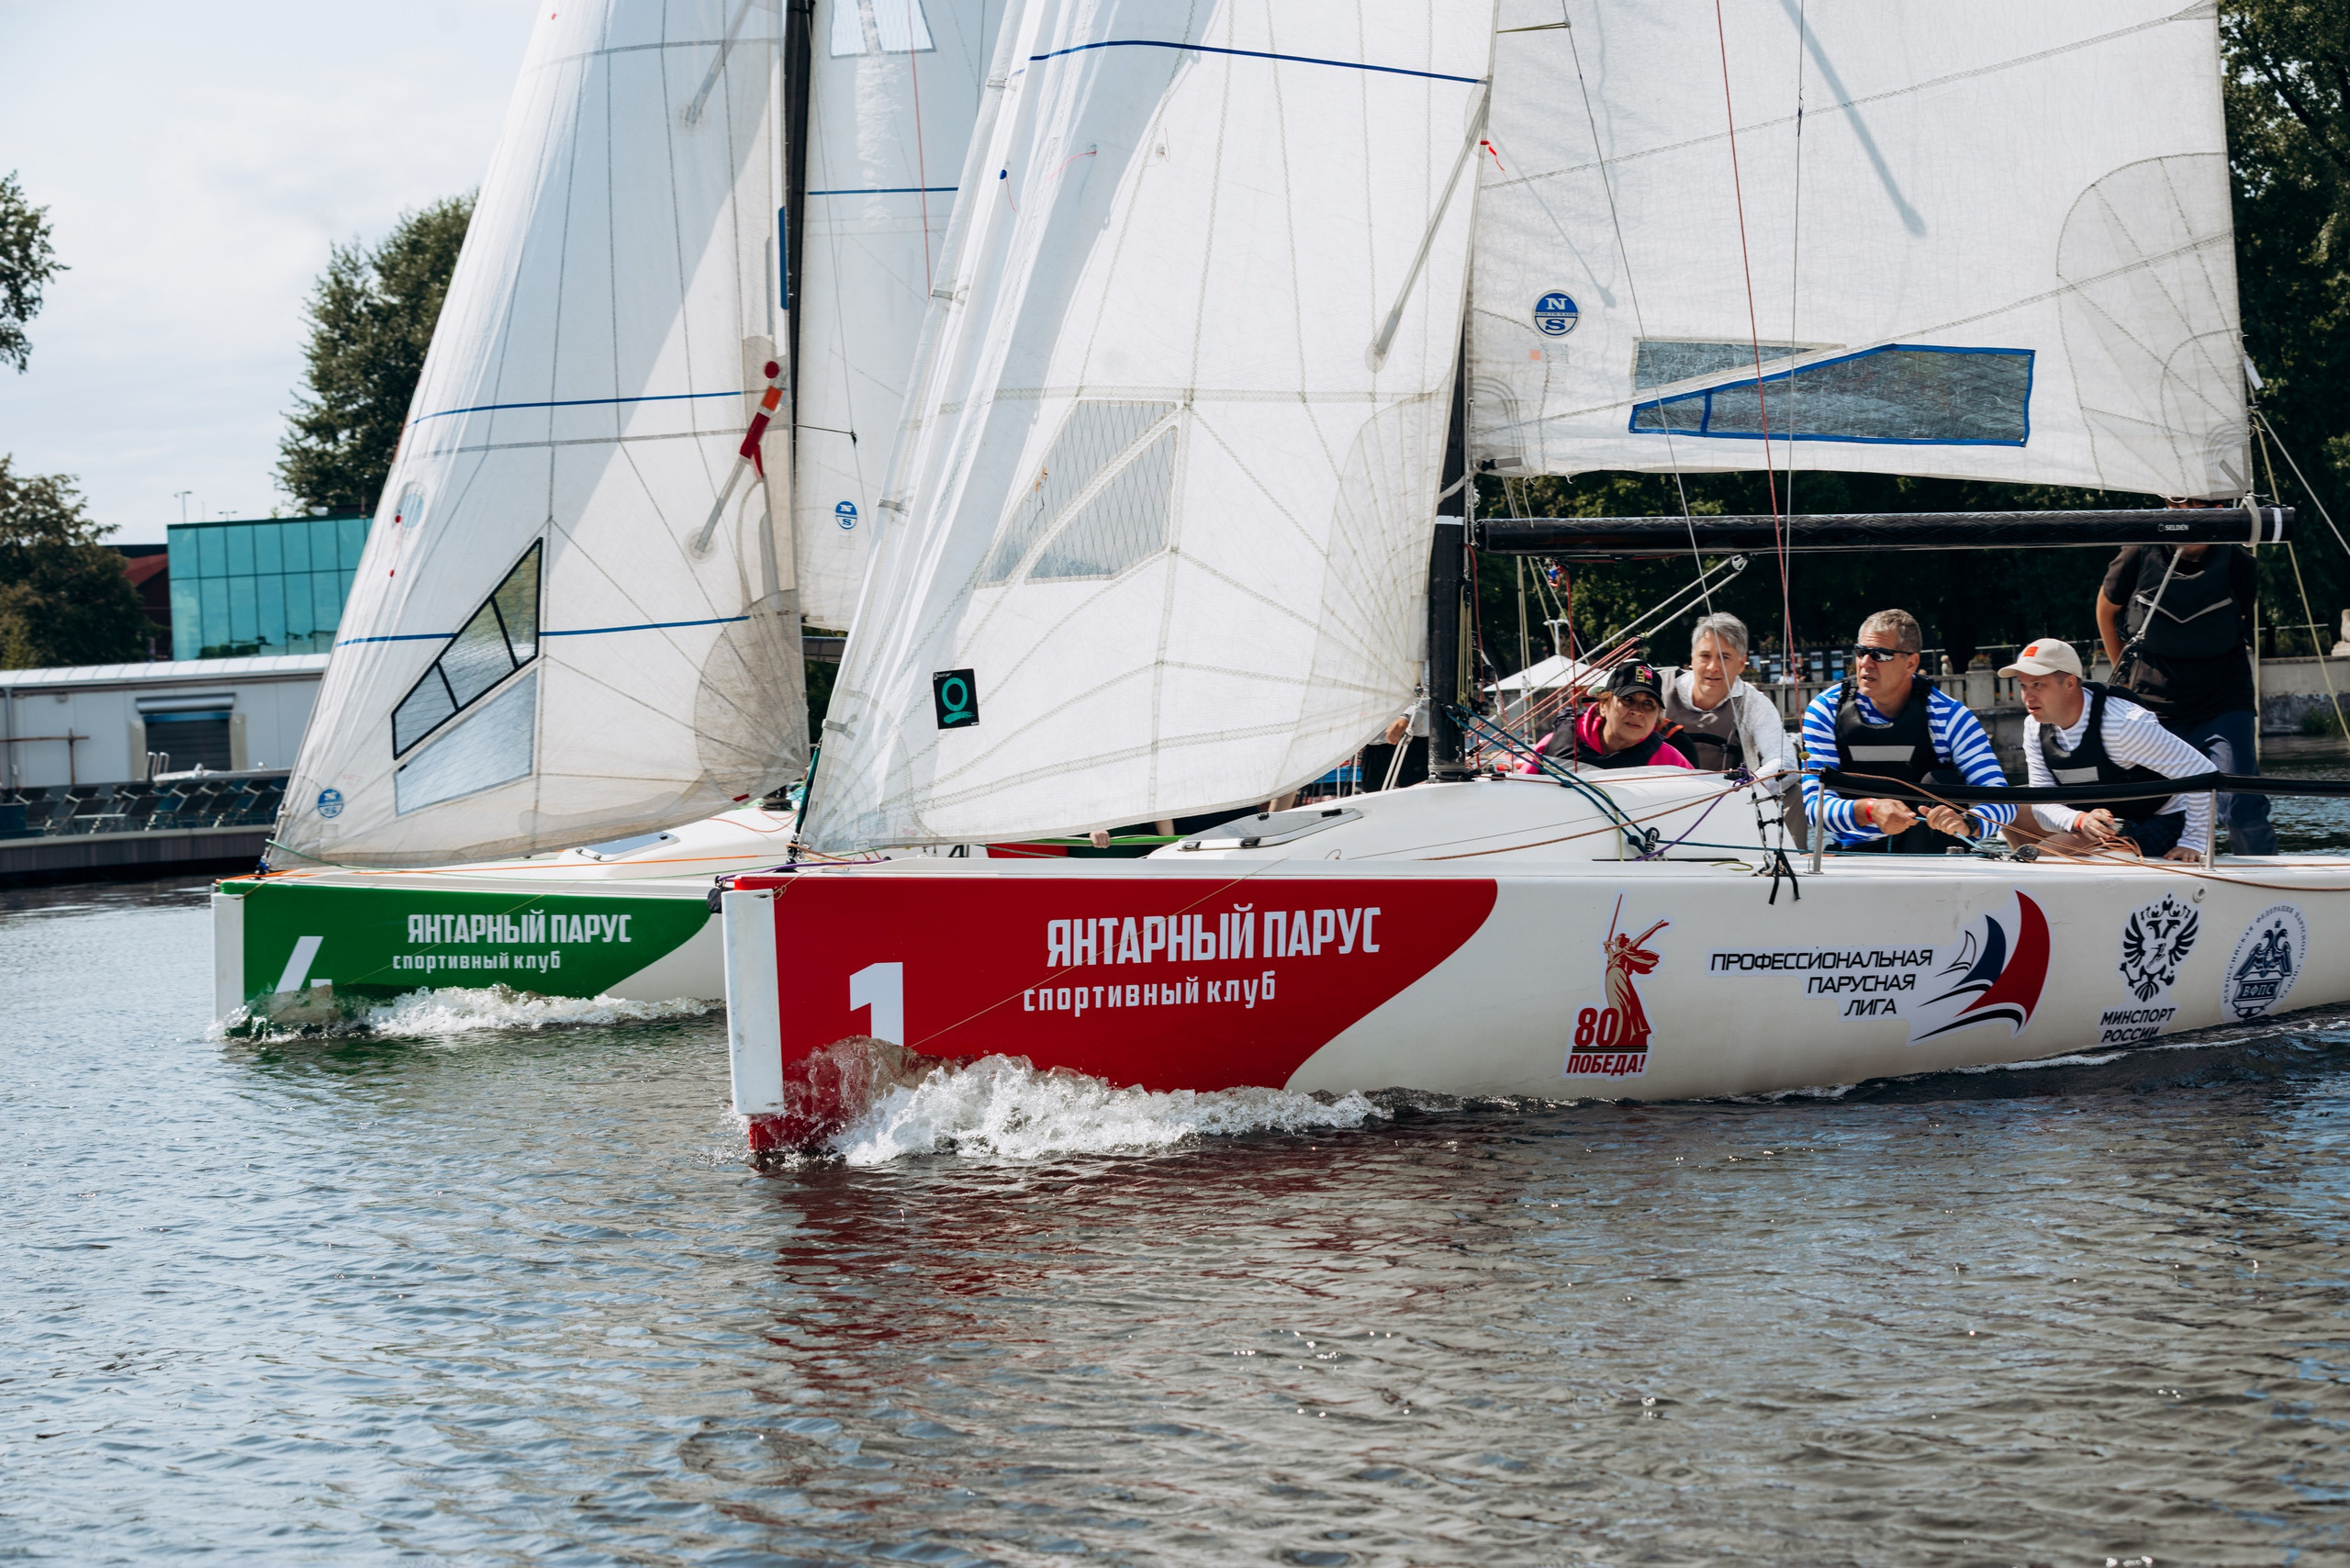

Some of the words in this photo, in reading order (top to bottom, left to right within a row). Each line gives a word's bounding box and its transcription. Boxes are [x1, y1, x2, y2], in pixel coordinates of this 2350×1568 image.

[1545, 297, 1568, 310] N
[1545, 319, 1566, 331] S
[408, 909, 546, 944] ЯНТАРНЫЙ
[551, 914, 632, 943] ПАРУС
[1046, 902, 1255, 967] ЯНТАРНЫЙ
[1263, 907, 1381, 958] ПАРУС
[393, 952, 509, 974] спортивный
[514, 950, 561, 974] клуб
[1711, 949, 1933, 971] ПРОФЕССИОНАЛЬНАЯ
[1024, 976, 1199, 1017] спортивный
[1207, 970, 1276, 1009] клуб
[1807, 974, 1916, 993] ПАРУСНАЯ
[2242, 984, 2275, 997] ВФПС
[849, 961, 904, 1047] 1
[1844, 999, 1897, 1016] ЛИГА
[1574, 1007, 1620, 1047] 80
[2099, 1007, 2176, 1025] МИНСПОРТ
[1566, 1054, 1647, 1077] ПОБЕДА!
